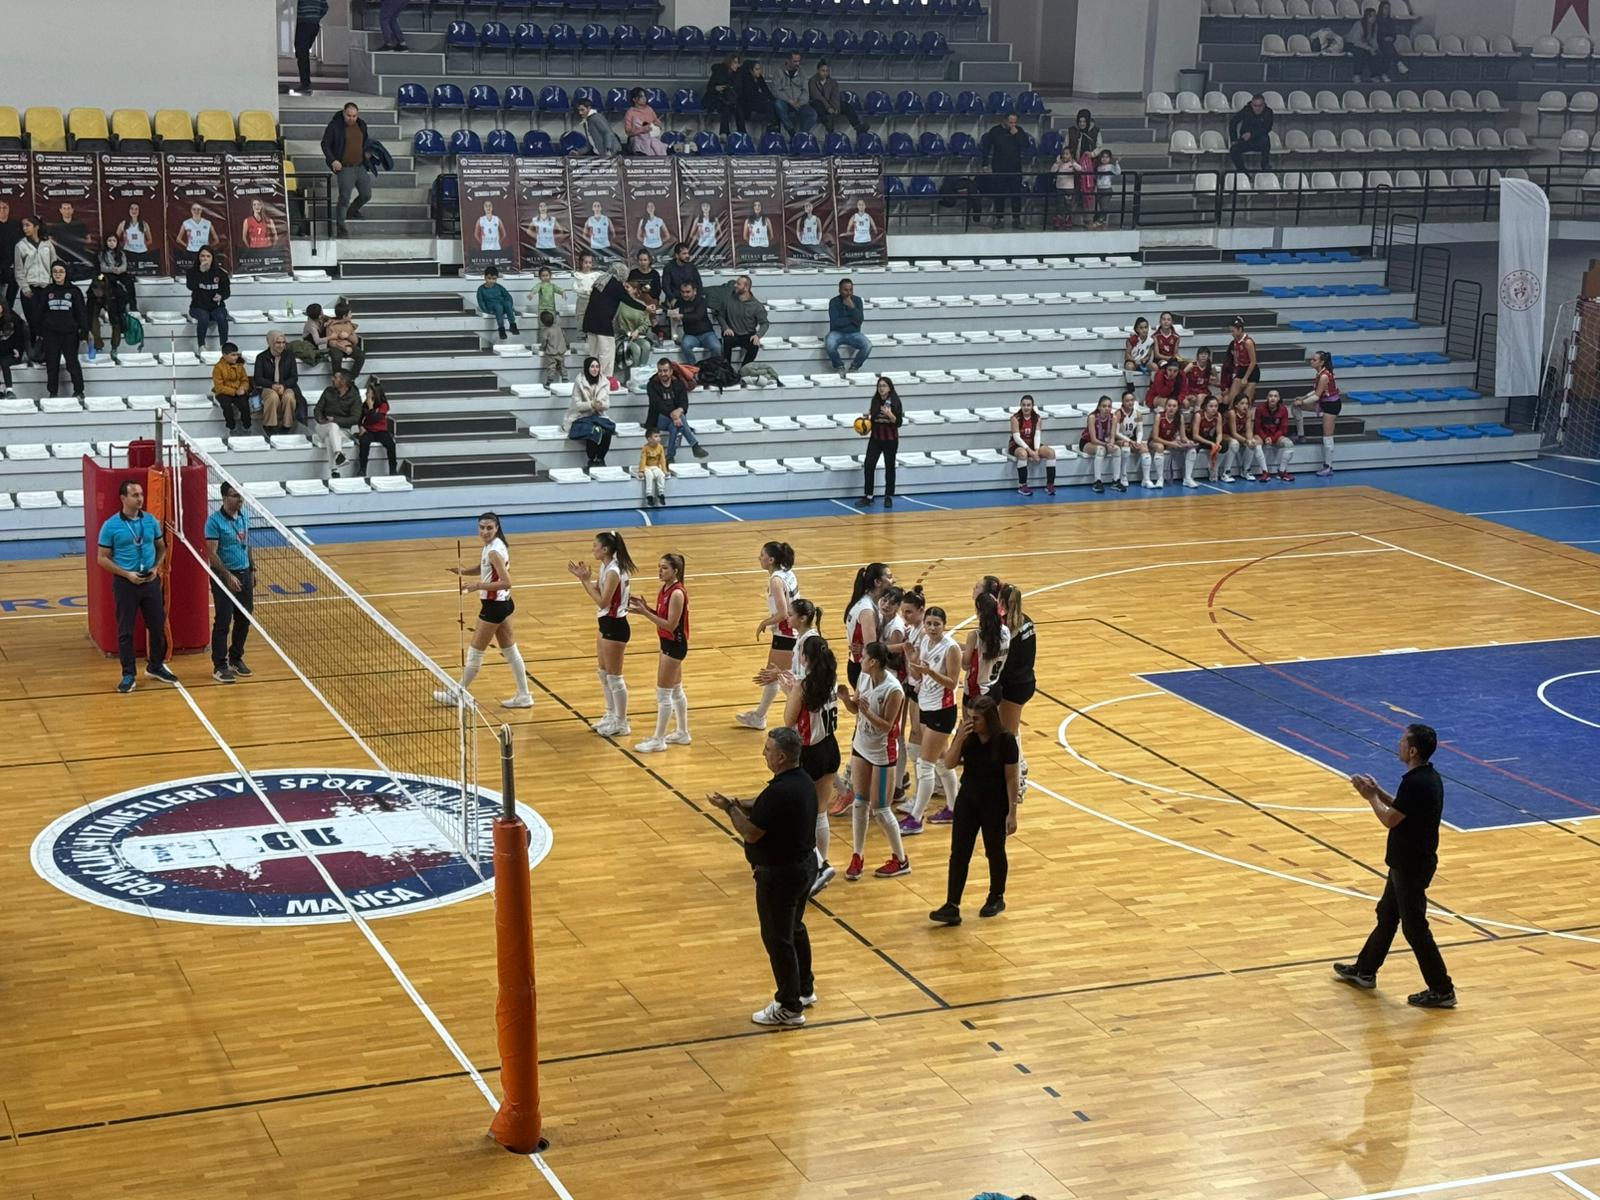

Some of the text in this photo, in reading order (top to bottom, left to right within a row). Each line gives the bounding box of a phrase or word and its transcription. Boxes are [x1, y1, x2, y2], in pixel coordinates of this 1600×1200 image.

[220, 779, 268, 794] VE
[279, 777, 373, 792] SPOR
[286, 887, 425, 915] MANİSA
